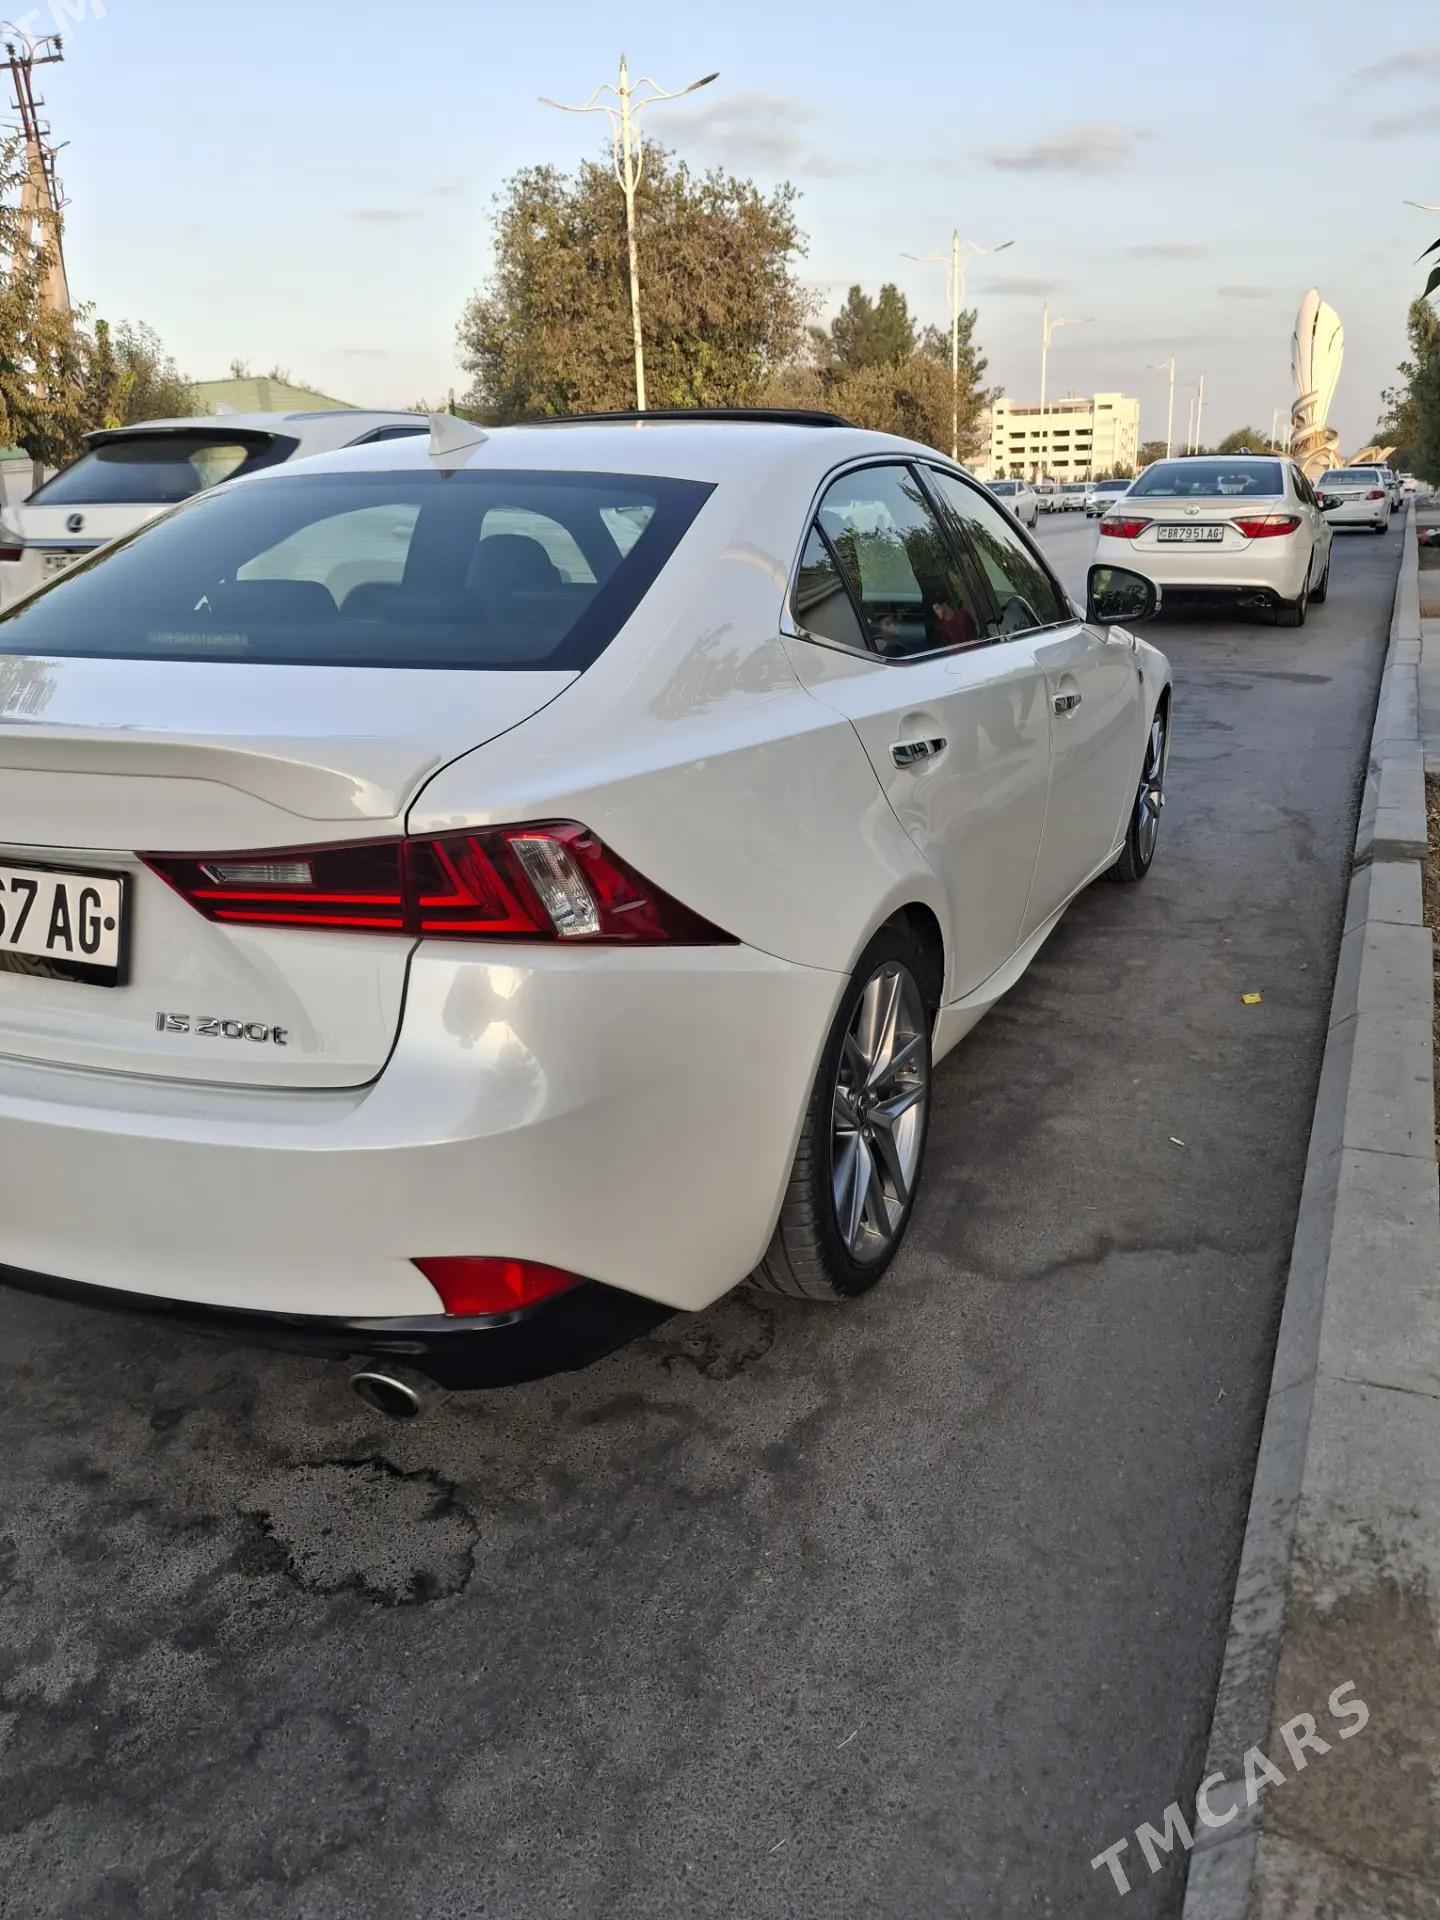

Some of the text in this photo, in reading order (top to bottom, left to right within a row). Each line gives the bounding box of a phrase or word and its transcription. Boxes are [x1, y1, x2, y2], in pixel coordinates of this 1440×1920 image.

[1207, 528, 1219, 538] AG
[0, 878, 101, 954] 7 AG
[156, 1012, 288, 1045] IS 200t
